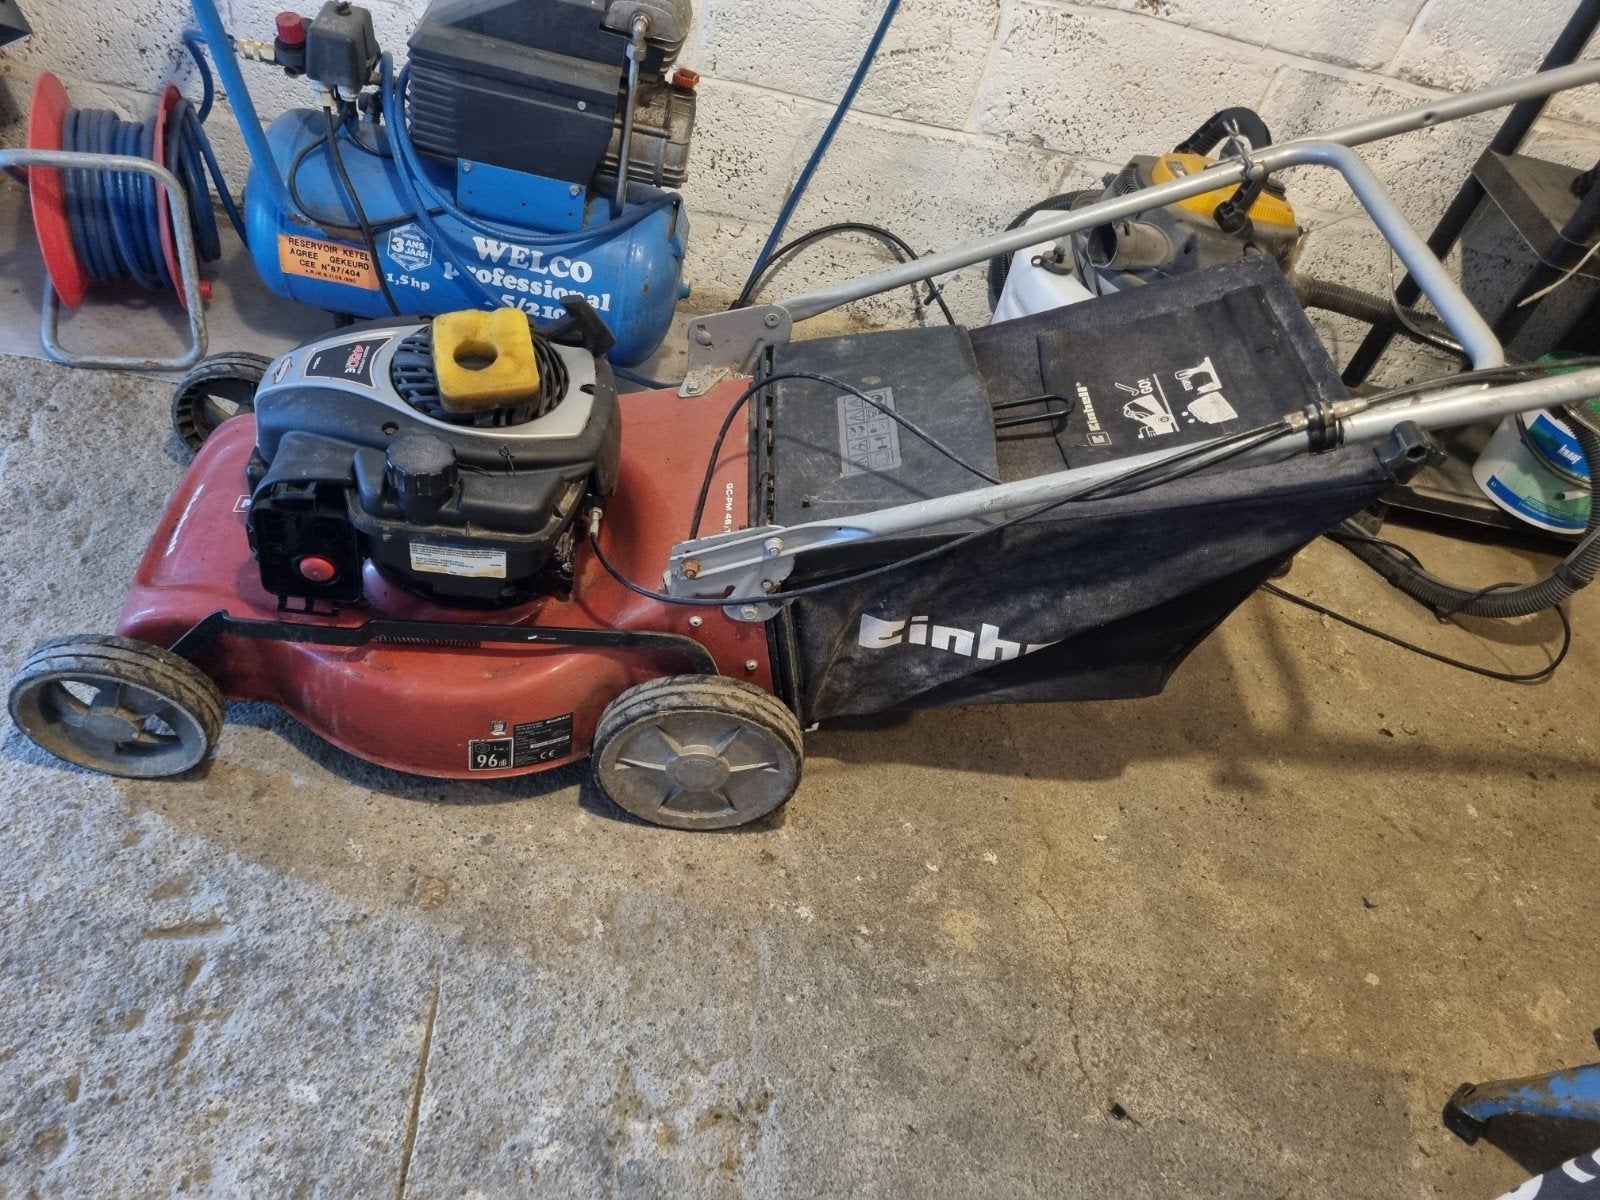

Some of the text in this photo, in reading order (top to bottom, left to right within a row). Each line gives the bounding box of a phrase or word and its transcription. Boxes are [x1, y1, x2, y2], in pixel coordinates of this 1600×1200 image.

[288, 237, 370, 262] RESERVOIR KETEL
[391, 237, 425, 253] 3 ANS
[404, 247, 429, 259] JAAR
[289, 247, 370, 271] AGREE GEKEURD
[299, 259, 316, 268] CEE
[472, 236, 593, 283] WELCO
[410, 277, 431, 291] hp
[1137, 377, 1154, 394] GO!
[725, 483, 734, 511] GC-PM
[476, 753, 508, 768] 96 dB
